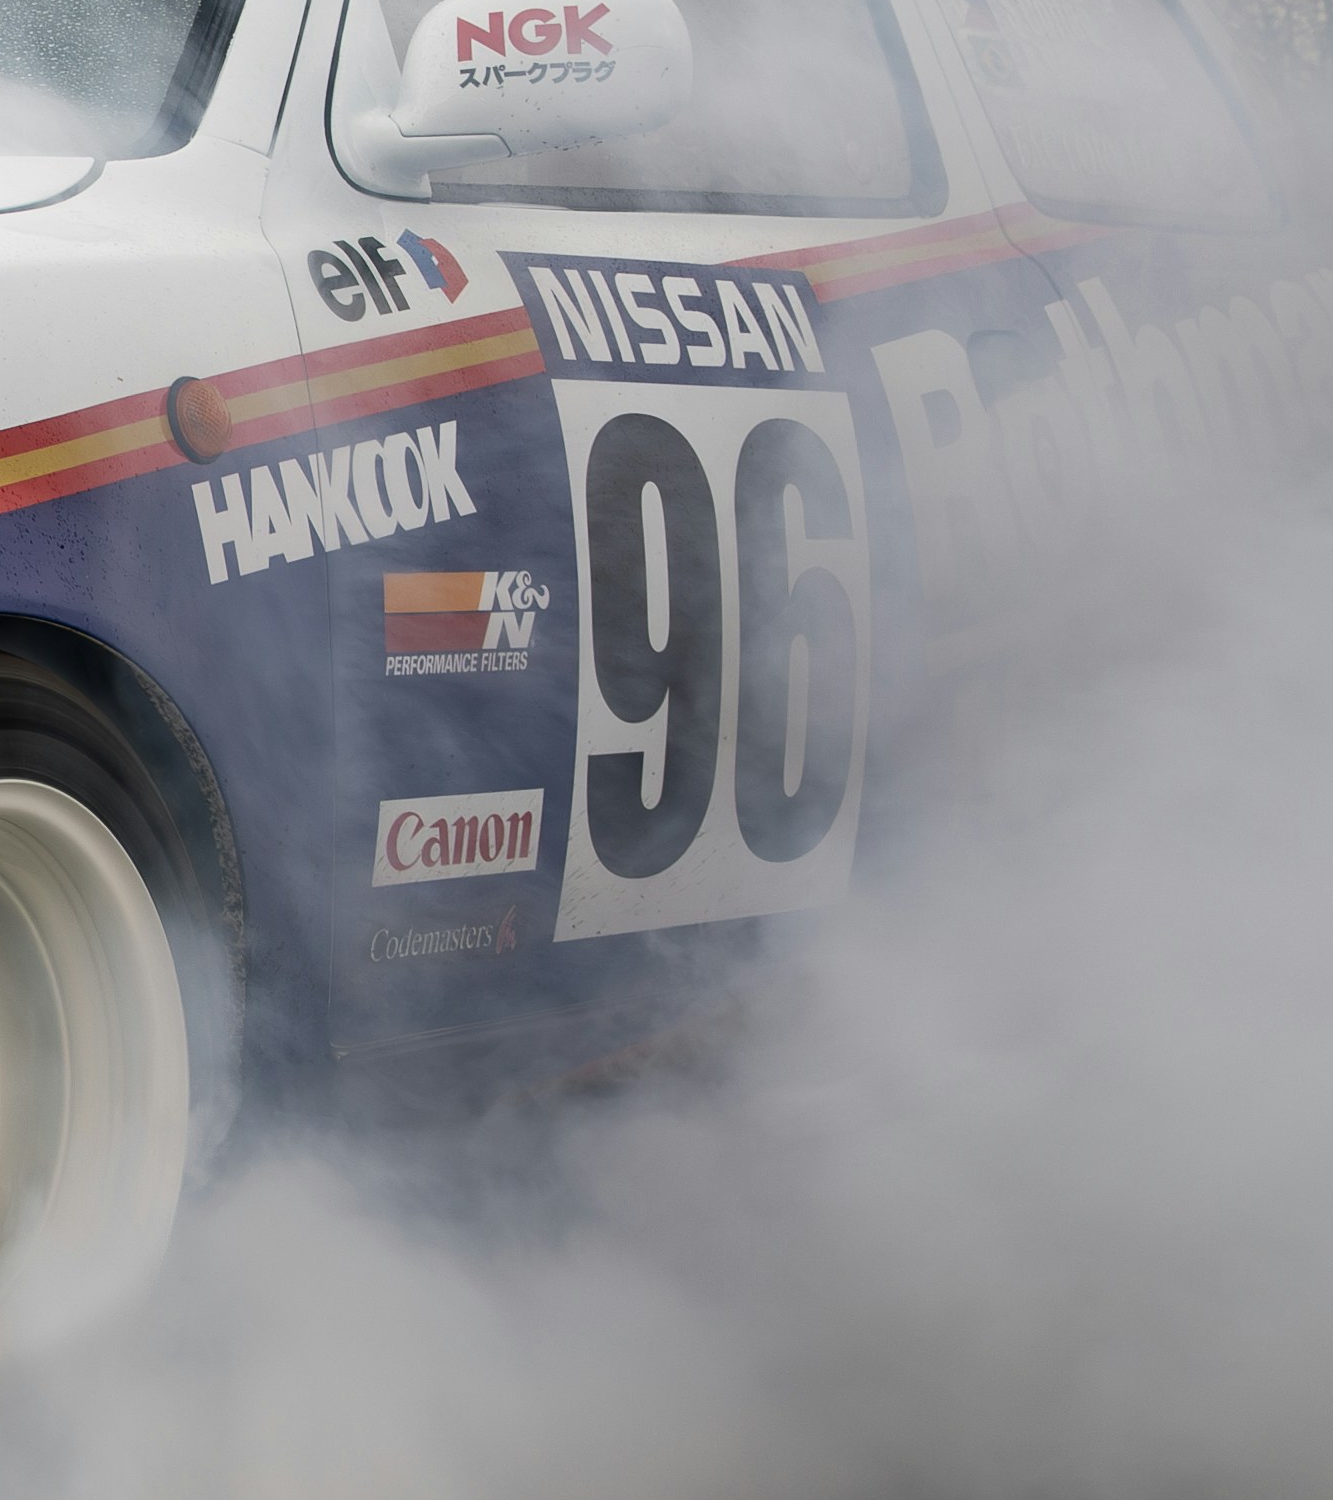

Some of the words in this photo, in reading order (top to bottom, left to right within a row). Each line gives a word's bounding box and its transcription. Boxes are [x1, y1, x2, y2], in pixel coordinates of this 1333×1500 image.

[456, 3, 614, 62] NGK
[459, 60, 616, 89] スパークプラグ
[307, 236, 411, 323] elf
[527, 266, 825, 373] NISSAN
[191, 420, 477, 585] HANKOOK
[385, 652, 478, 677] PERFORMANCE
[480, 650, 529, 673] FILTERS
[585, 412, 857, 880] 96
[386, 810, 533, 872] Canon
[370, 923, 493, 963] Codemasters
